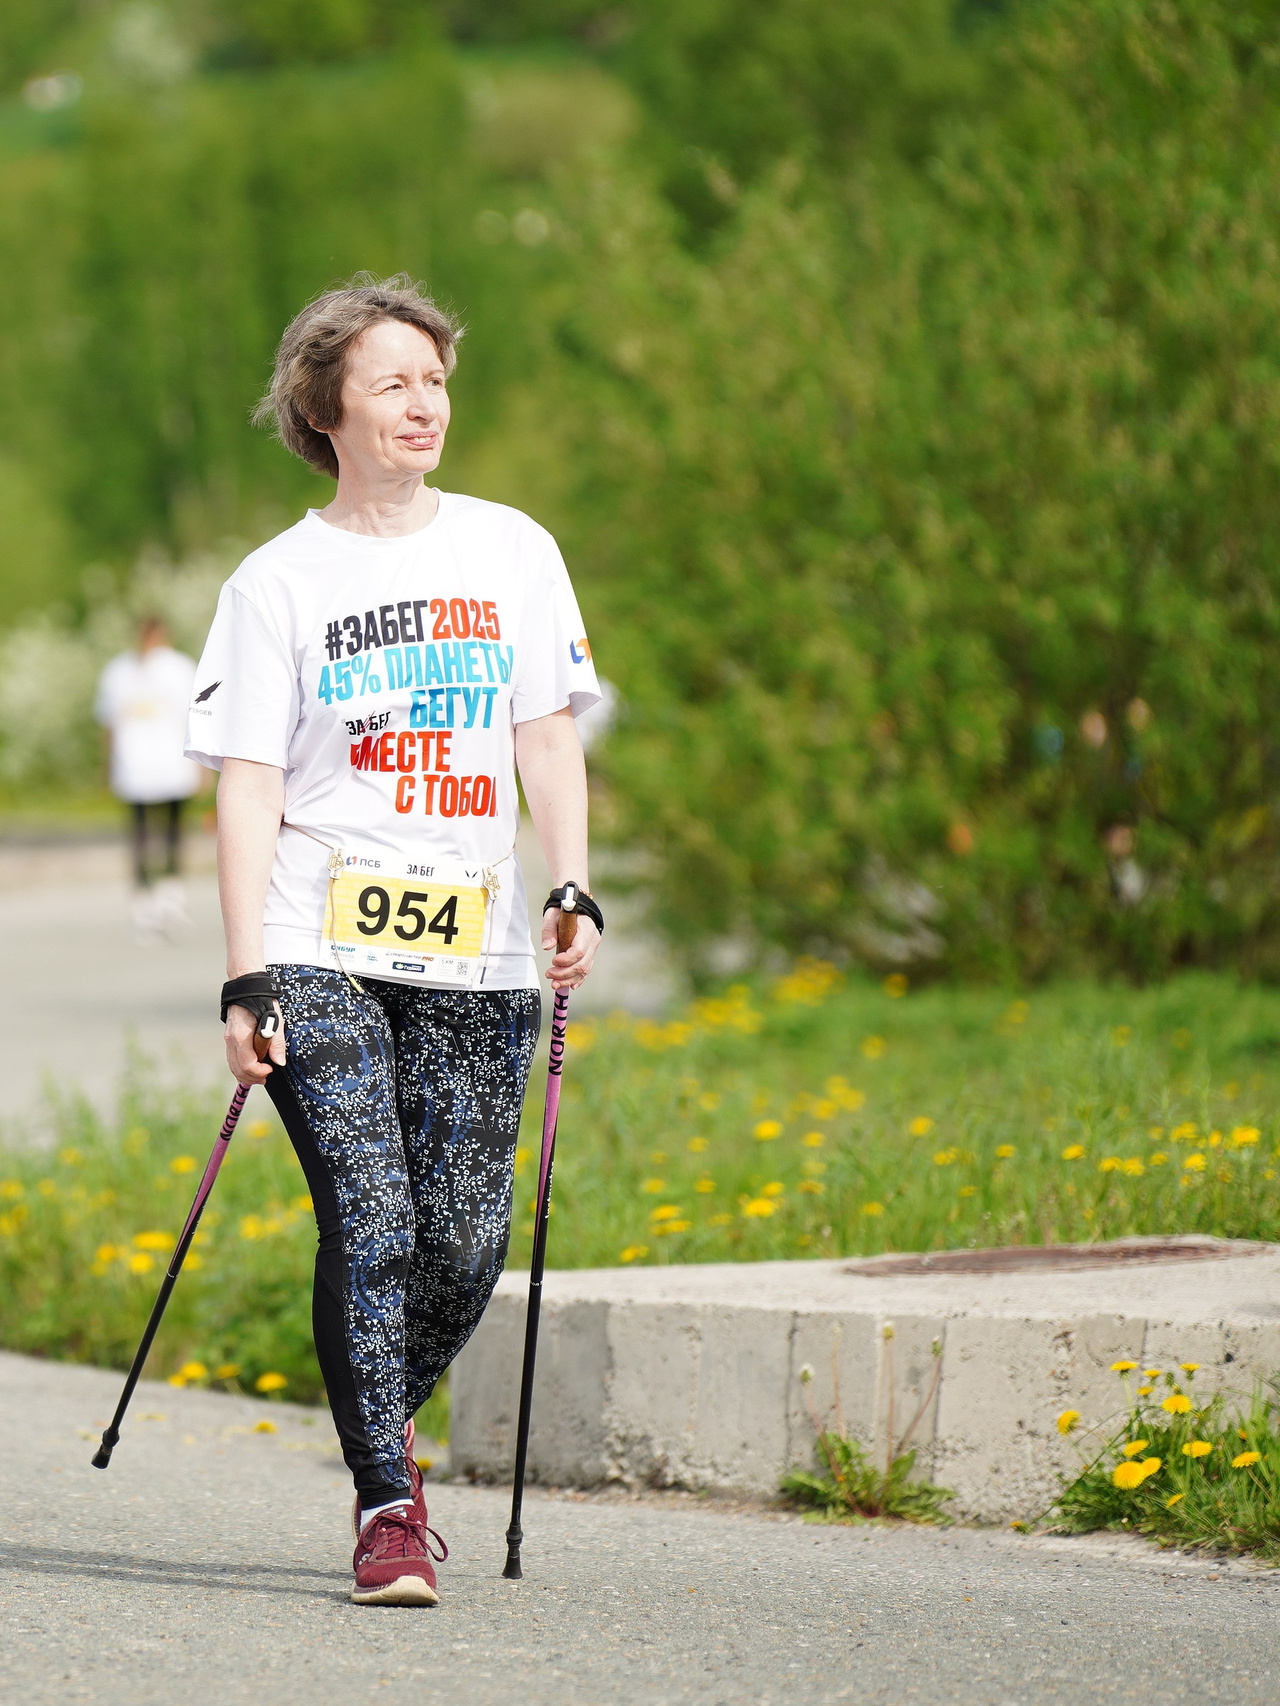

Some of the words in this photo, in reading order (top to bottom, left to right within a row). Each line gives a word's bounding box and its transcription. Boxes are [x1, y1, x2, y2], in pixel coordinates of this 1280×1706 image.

[325, 598, 501, 661] #ЗАБЕГ2025
[318, 653, 382, 706] 45%
[383, 641, 514, 690] ПЛАНЕТЫ
[409, 686, 498, 729] БЕГУТ
[395, 775, 416, 814] С
[359, 858, 381, 868] ПСБ
[356, 886, 459, 945] 954
[548, 991, 569, 1076] NORTH
